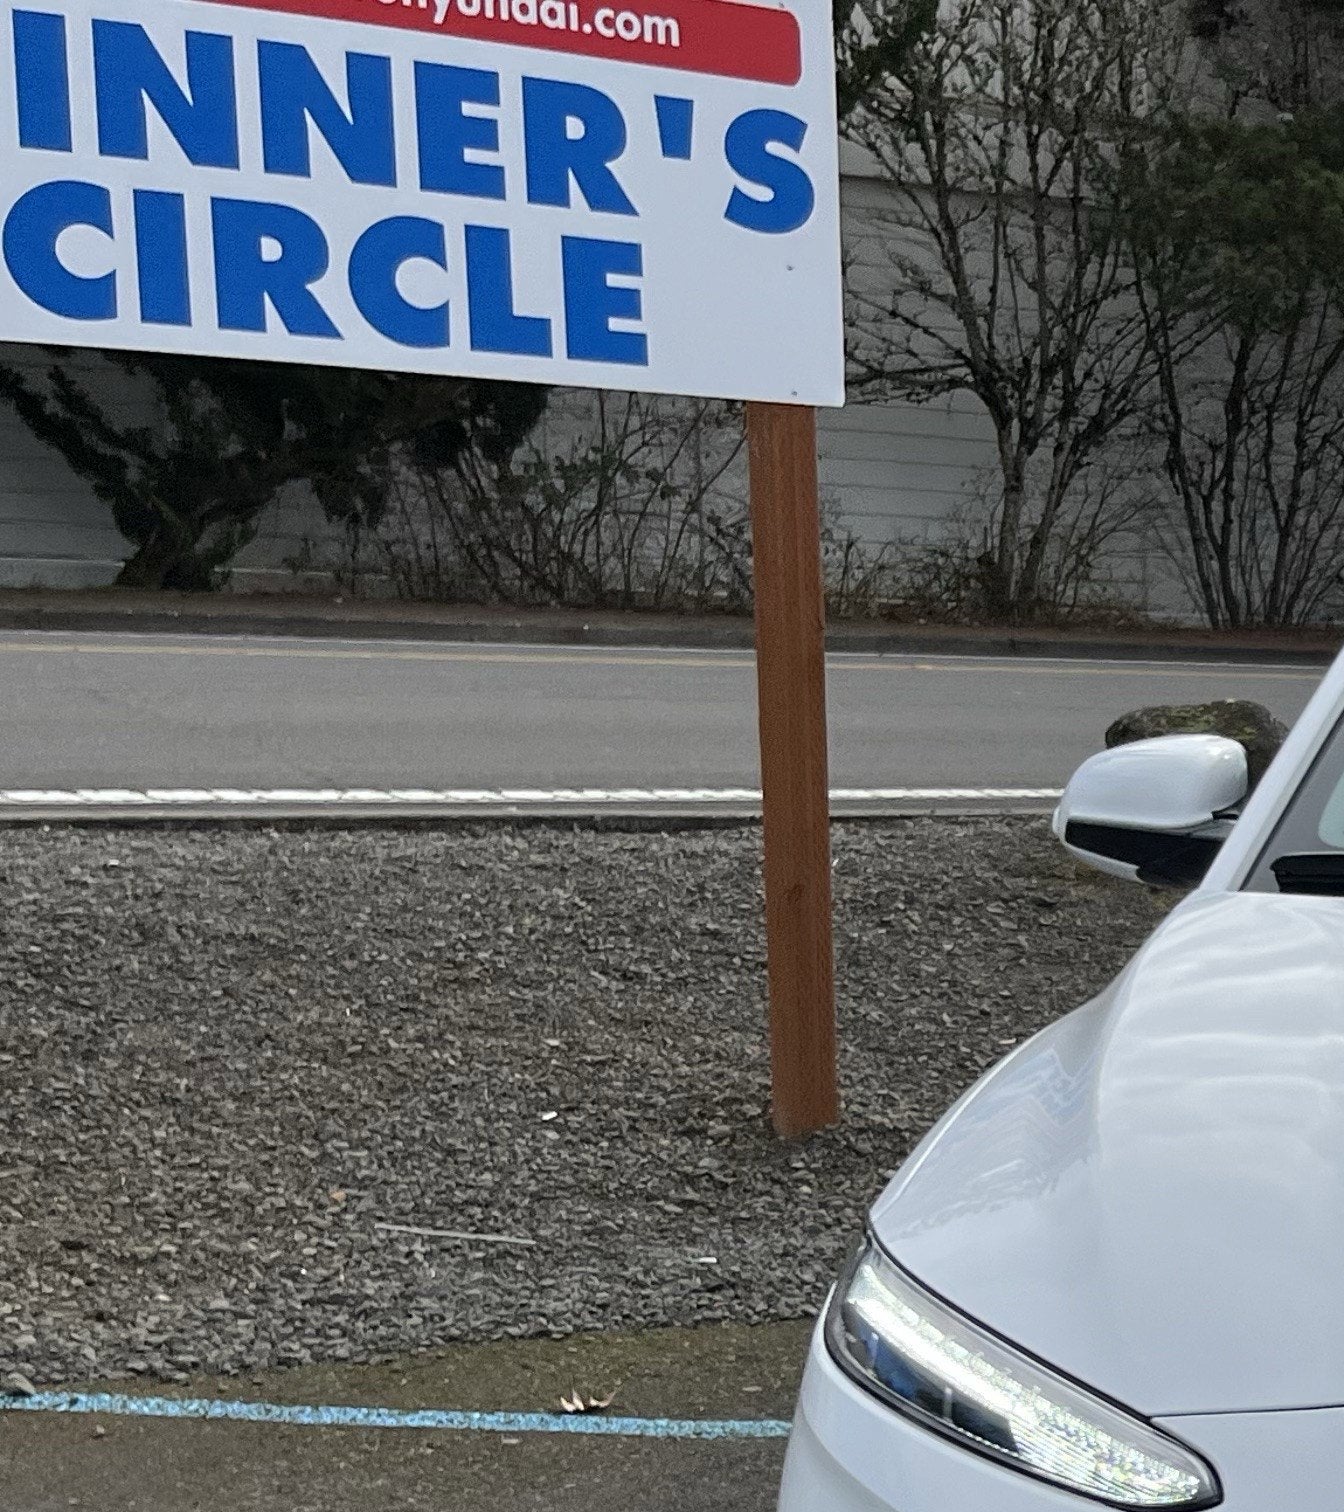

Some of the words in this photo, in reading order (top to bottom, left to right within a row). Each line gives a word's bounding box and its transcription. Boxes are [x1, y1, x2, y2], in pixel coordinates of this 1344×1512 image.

[378, 0, 681, 47] yundai.com
[12, 8, 815, 233] INNER'S
[2, 180, 648, 366] CIRCLE
